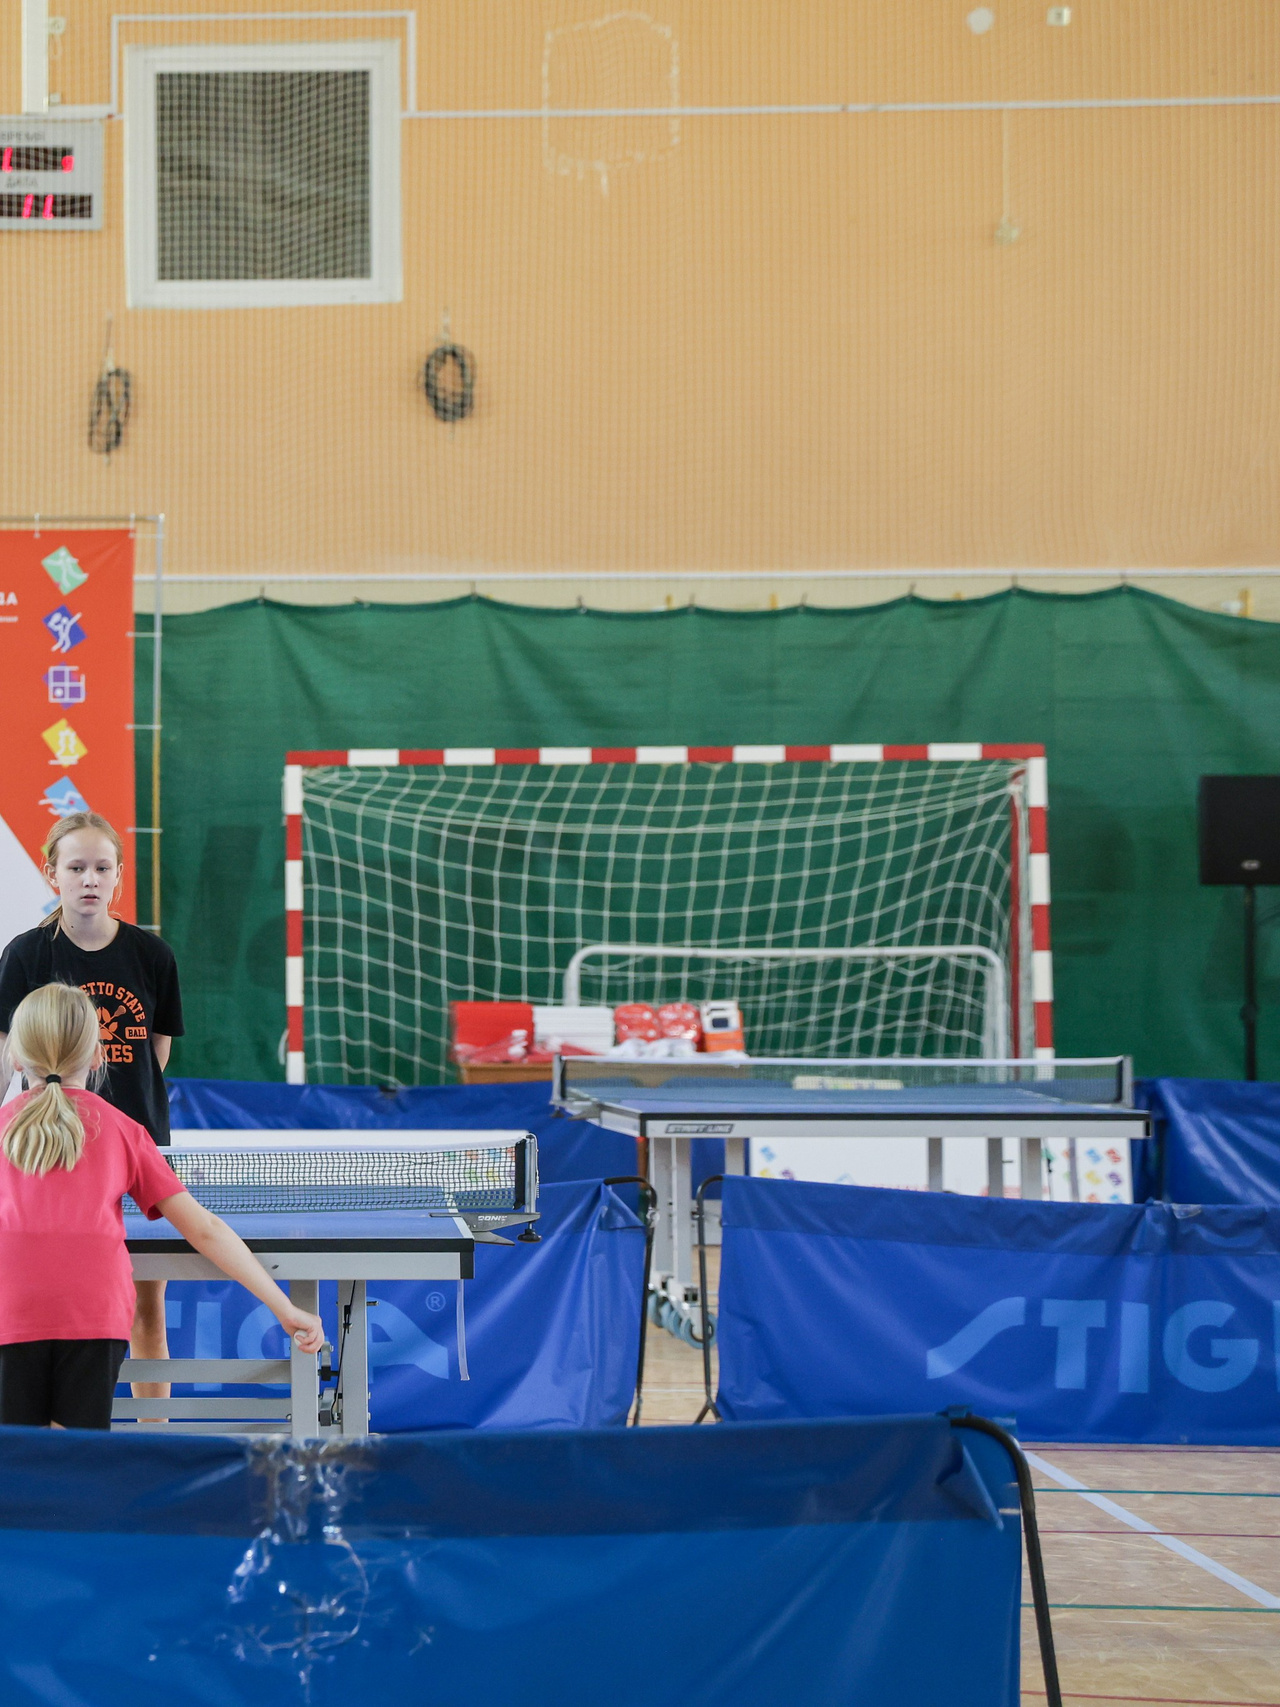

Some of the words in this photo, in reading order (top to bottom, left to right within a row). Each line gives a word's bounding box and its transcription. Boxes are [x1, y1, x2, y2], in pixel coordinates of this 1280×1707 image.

[115, 986, 146, 1023] STATE
[128, 1029, 146, 1037] BALL
[926, 1296, 1280, 1394] STIG
